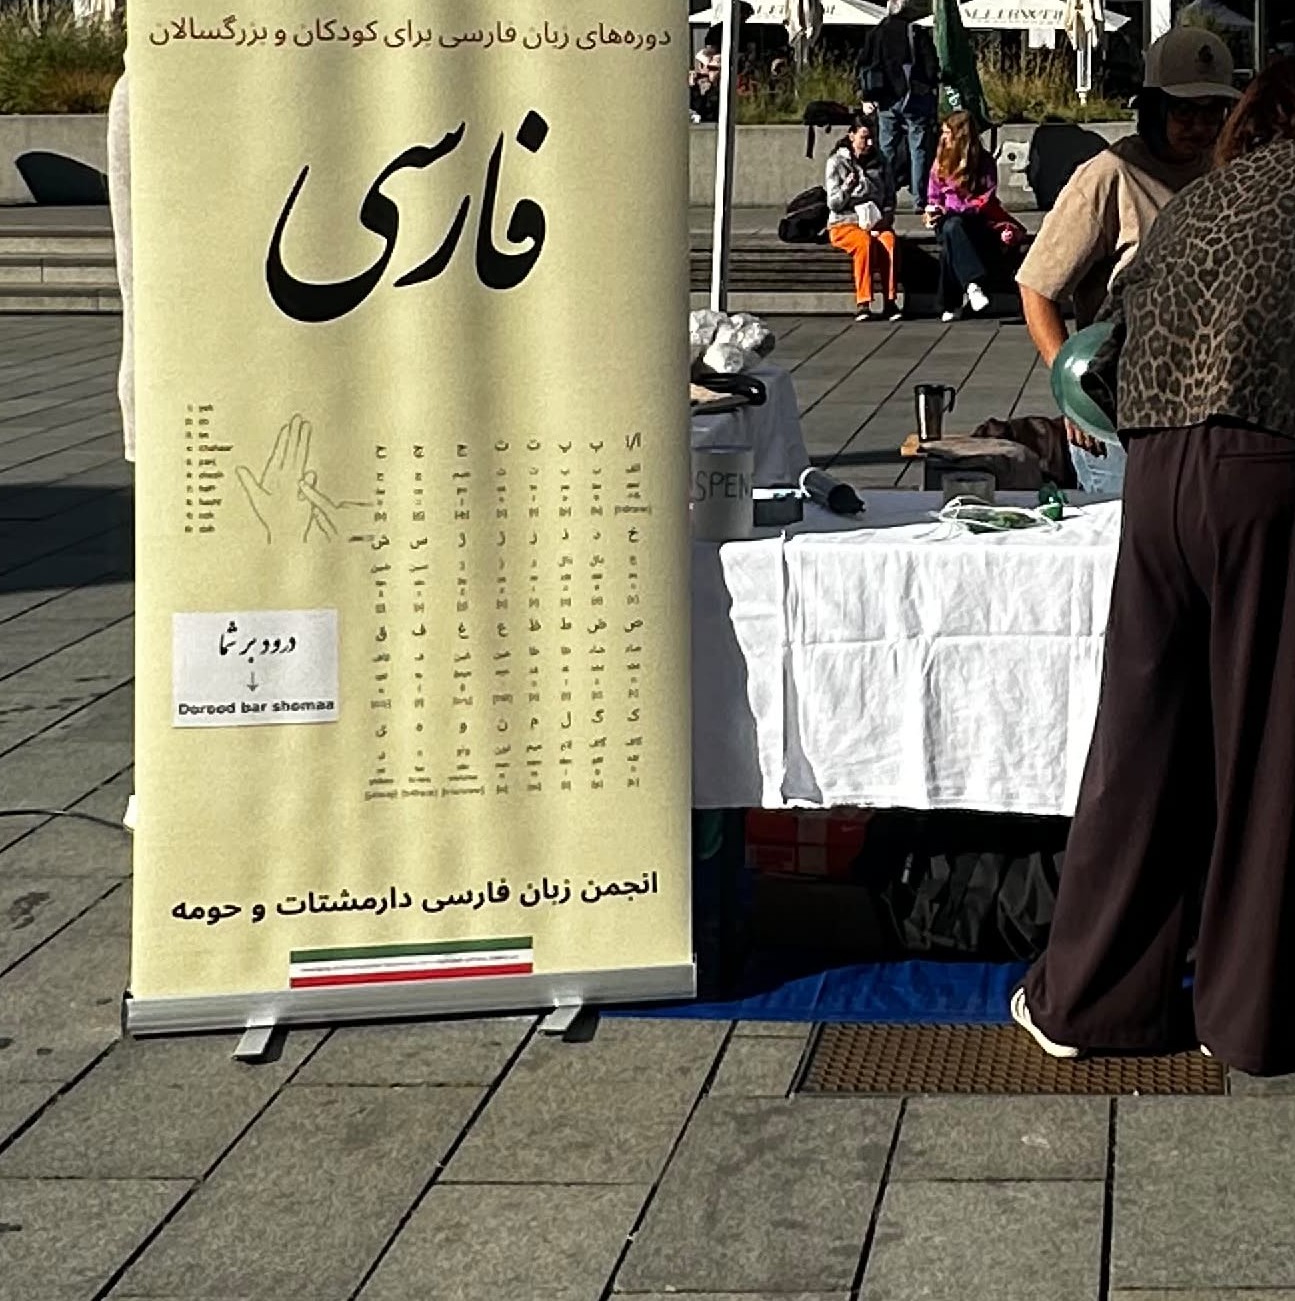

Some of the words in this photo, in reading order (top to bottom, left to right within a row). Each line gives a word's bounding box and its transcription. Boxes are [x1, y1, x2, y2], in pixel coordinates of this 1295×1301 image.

[149, 14, 268, 46] بزرگسالان
[274, 27, 287, 46] و
[293, 17, 379, 48] کودکان
[383, 18, 433, 49] برای
[438, 20, 517, 49] فارسی
[522, 20, 570, 50] زبان
[266, 109, 549, 323] فارسی
[241, 701, 267, 714] bar
[272, 699, 335, 713] shomaa
[276, 886, 413, 916] دارمشتات
[422, 877, 511, 914] فارسی
[519, 876, 572, 908] زبان
[580, 870, 658, 904] انجمن
[171, 901, 242, 926] حومه
[251, 903, 266, 924] و
